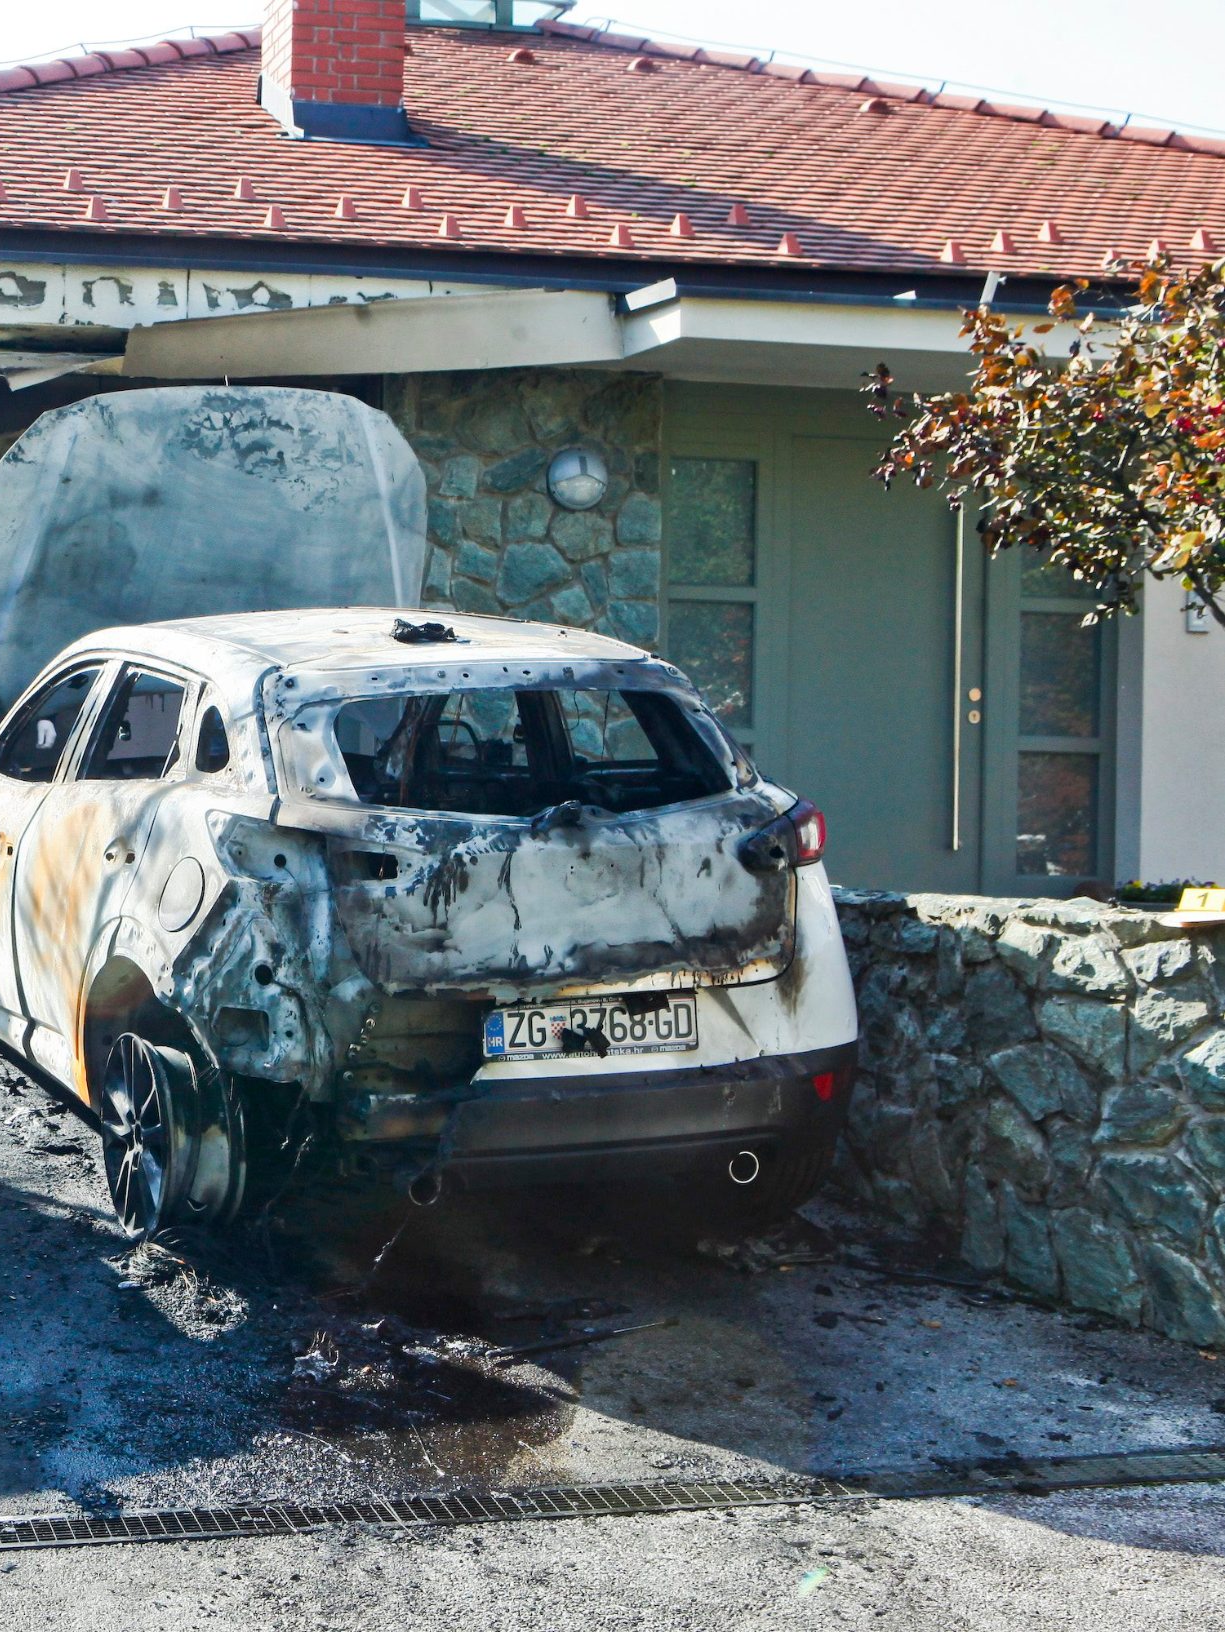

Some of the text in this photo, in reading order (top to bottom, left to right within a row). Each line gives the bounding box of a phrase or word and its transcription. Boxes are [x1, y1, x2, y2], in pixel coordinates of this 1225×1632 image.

[1197, 892, 1209, 907] 1
[507, 1010, 547, 1048] ZG
[488, 1036, 504, 1047] HR
